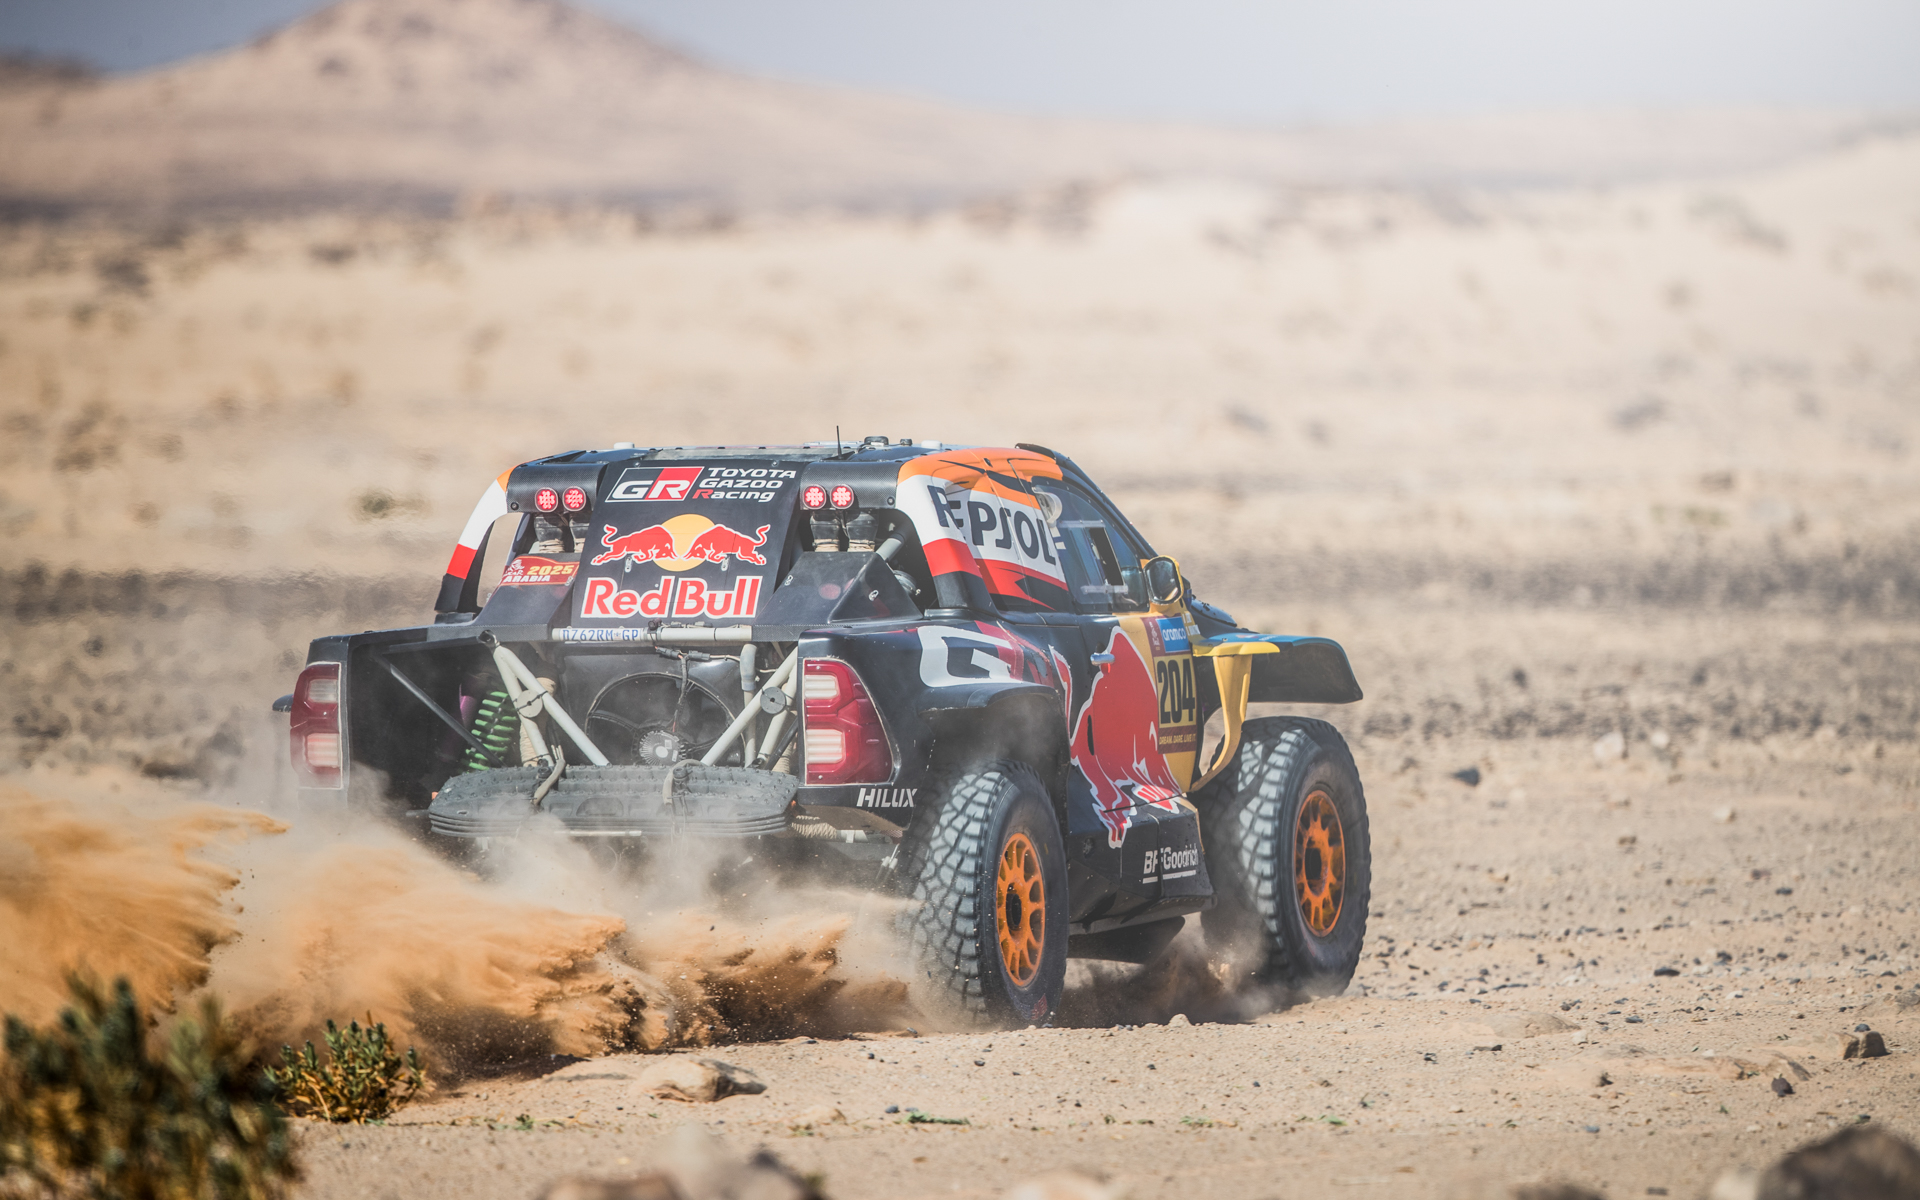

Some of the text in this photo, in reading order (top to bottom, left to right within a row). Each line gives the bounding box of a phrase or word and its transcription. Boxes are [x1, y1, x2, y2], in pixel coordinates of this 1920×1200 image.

[707, 467, 797, 479] TOYOTA
[611, 480, 691, 500] GR
[698, 478, 784, 489] GAZOO
[692, 489, 776, 503] Racing
[527, 565, 574, 576] 2025
[582, 577, 761, 618] Red Bull
[622, 629, 639, 641] GP
[1162, 627, 1187, 641] aramco
[1158, 658, 1195, 724] 204
[856, 787, 918, 808] HILUX
